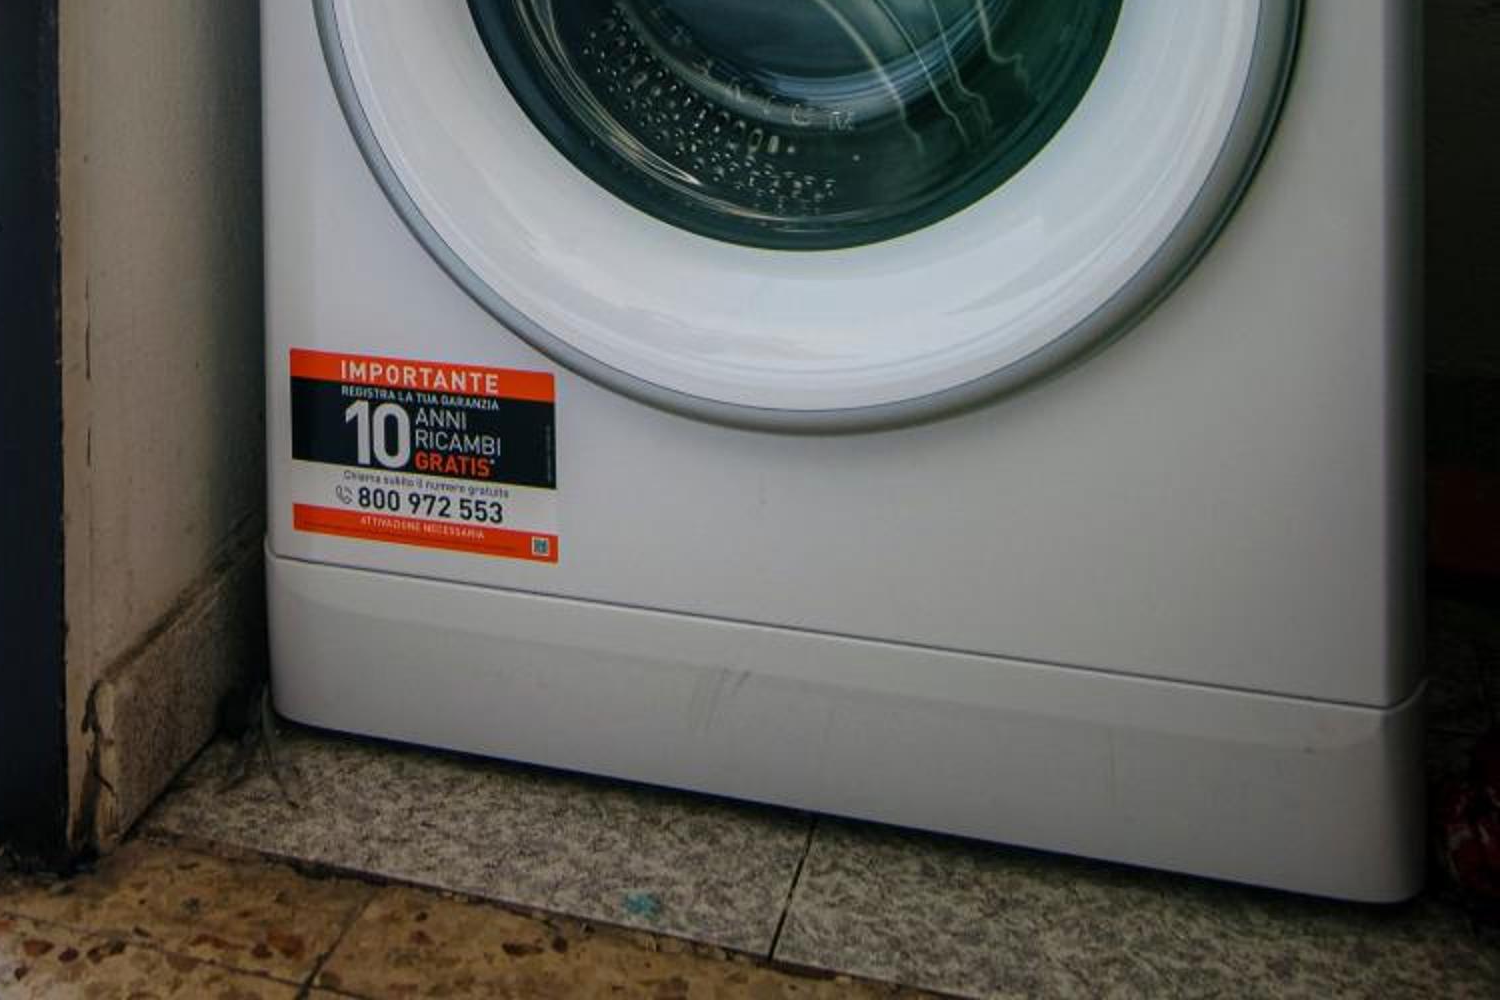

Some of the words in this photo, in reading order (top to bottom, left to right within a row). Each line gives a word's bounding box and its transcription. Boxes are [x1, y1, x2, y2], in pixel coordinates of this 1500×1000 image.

[340, 360, 500, 394] IMPORTANTE
[341, 385, 397, 402] REGISTRA
[398, 391, 413, 404] LA
[415, 393, 438, 406] TUA
[440, 396, 500, 411] GARANZIA
[344, 399, 411, 469] 10
[414, 407, 468, 431] ANNI
[414, 428, 501, 457] RICAMBI
[357, 486, 401, 512] 800
[408, 492, 452, 519] 972
[458, 498, 504, 525] 553
